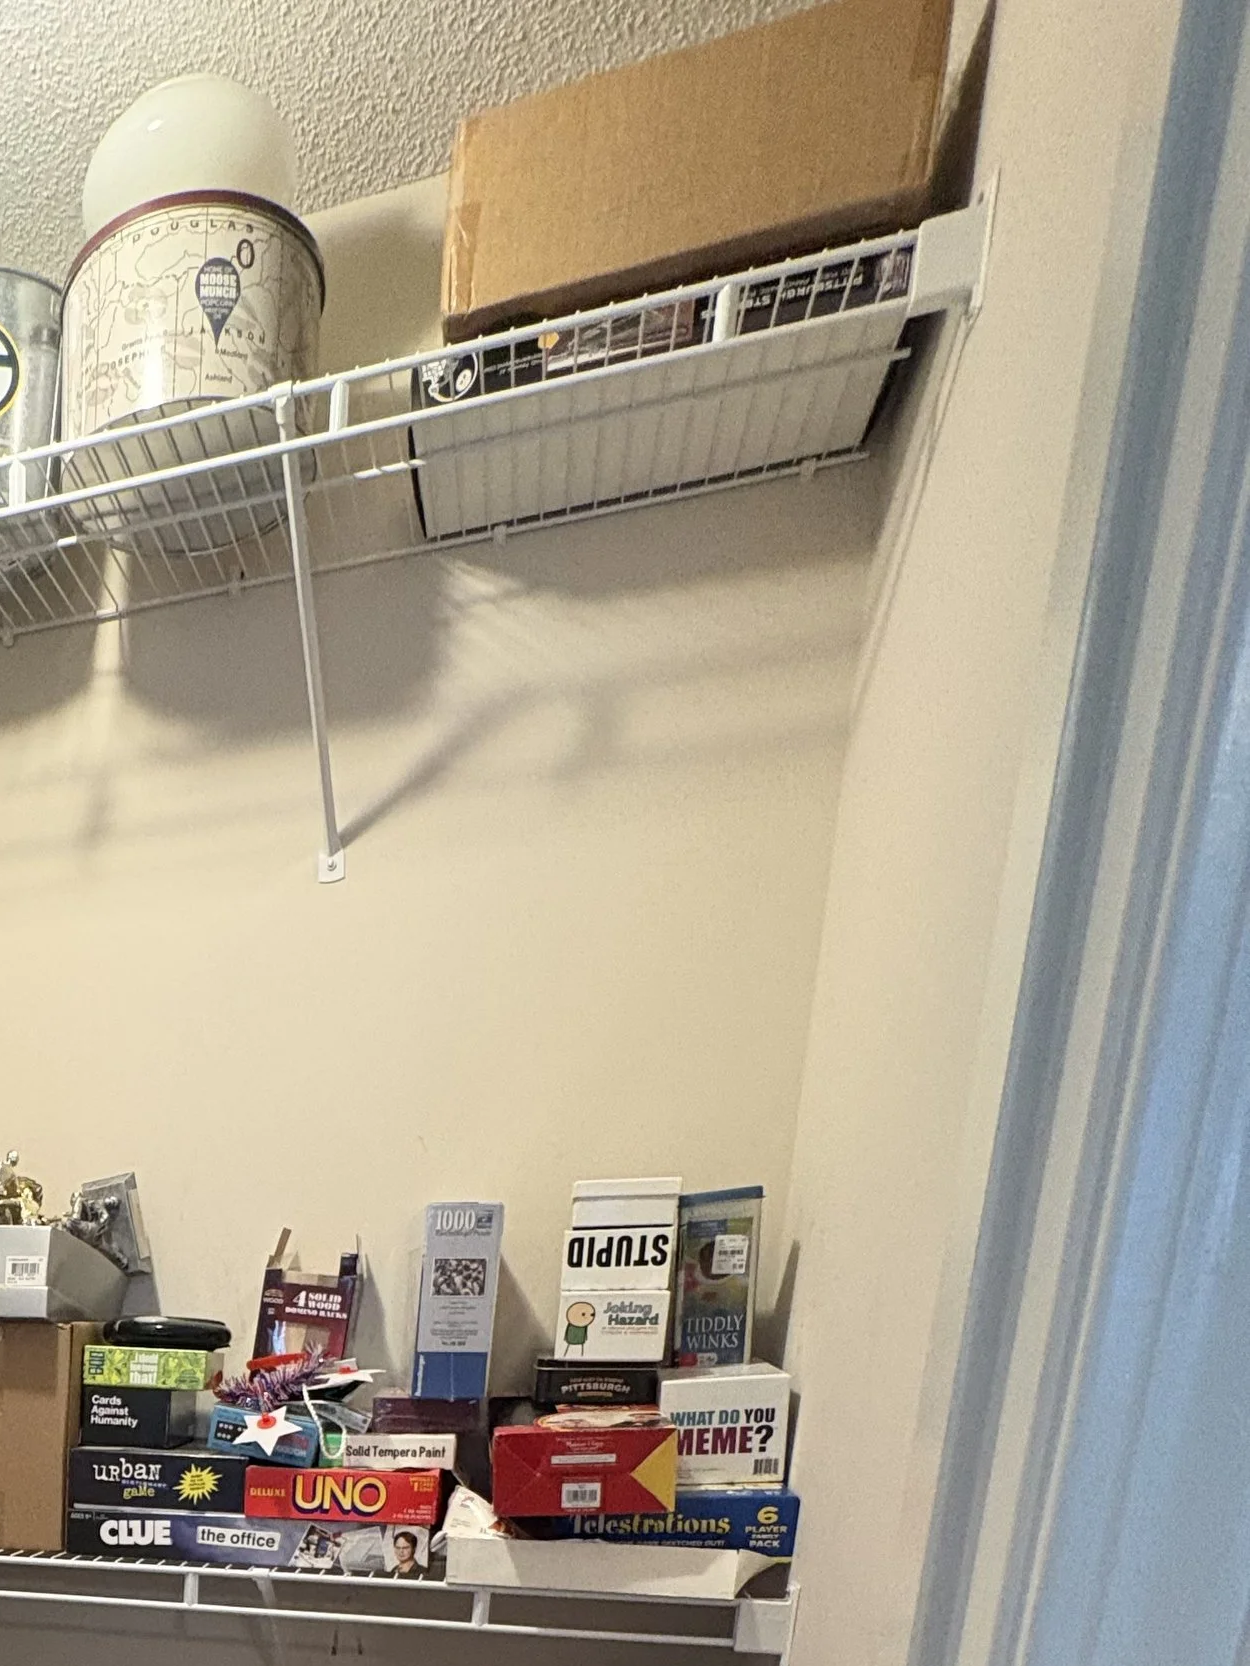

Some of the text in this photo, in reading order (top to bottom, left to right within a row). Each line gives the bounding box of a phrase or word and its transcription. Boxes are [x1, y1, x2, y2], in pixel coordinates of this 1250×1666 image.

[132, 218, 254, 244] DOUGLAS
[199, 273, 237, 287] MOOSE
[199, 286, 237, 299] MUNCH
[188, 326, 266, 344] JAKSON
[205, 373, 233, 384] Ashland
[435, 1208, 476, 1231] 1000
[567, 1234, 669, 1268] STUPID
[293, 1291, 342, 1308] 4 SOLID
[307, 1300, 341, 1311] WOOD
[285, 1306, 318, 1316] DOMINO
[603, 1301, 653, 1318] Joking
[608, 1313, 659, 1325] Hazard
[685, 1314, 744, 1333] TIDDLY
[685, 1332, 739, 1350] WINKS
[560, 1382, 631, 1394] PITTSBURGH
[91, 1395, 122, 1405] Cards
[91, 1406, 129, 1417] Against
[670, 1407, 776, 1426] WHAT DO YOU
[90, 1415, 138, 1428] Humanity
[676, 1424, 774, 1456] MEME?
[345, 1445, 446, 1460] Solid Tempera Paint
[250, 1487, 286, 1497] DELUXE
[293, 1474, 387, 1516] UNO
[573, 1511, 731, 1535] Telestrations
[757, 1506, 779, 1525] 6
[100, 1519, 276, 1549] CLUE the office
[745, 1525, 788, 1534] PLAYER
[749, 1539, 781, 1548] PACK
